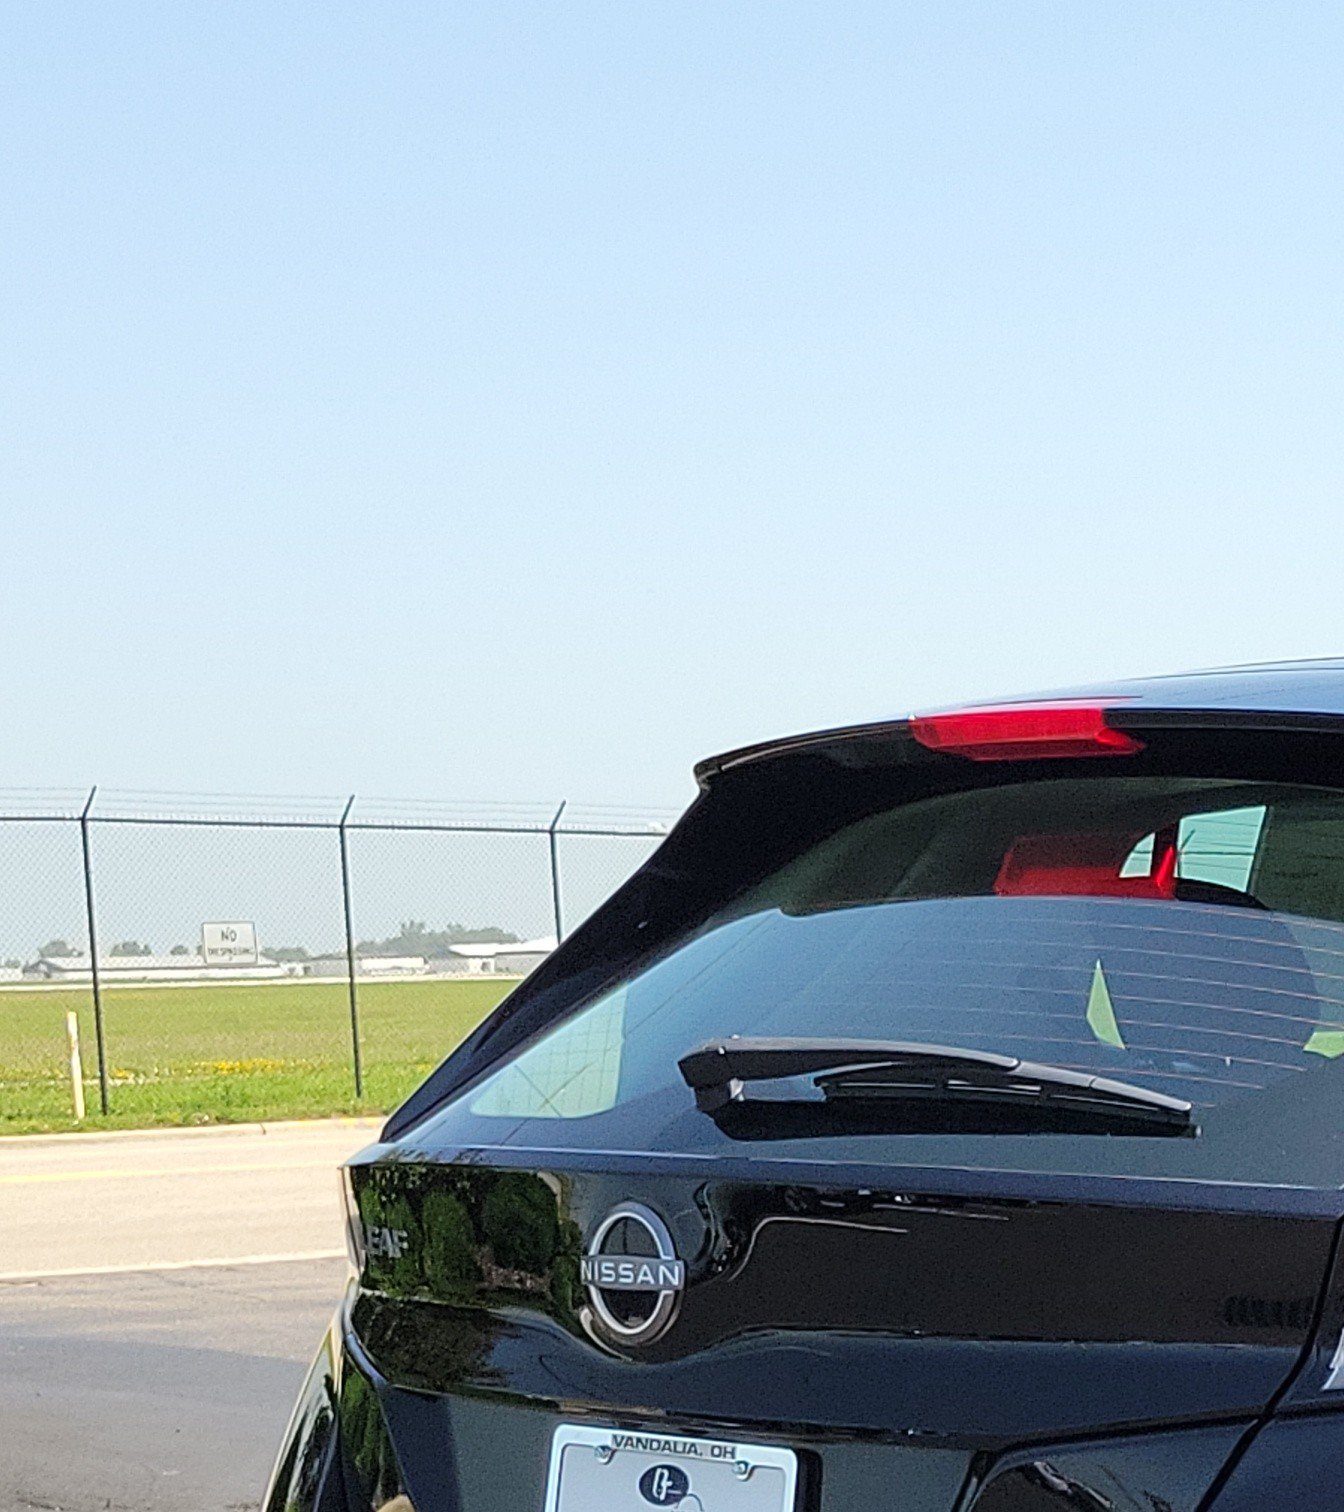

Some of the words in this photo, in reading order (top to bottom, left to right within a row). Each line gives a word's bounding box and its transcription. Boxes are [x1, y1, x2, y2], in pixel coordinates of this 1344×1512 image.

[221, 927, 237, 942] NO
[581, 1259, 680, 1287] NISSAN
[711, 1445, 737, 1459] OH
